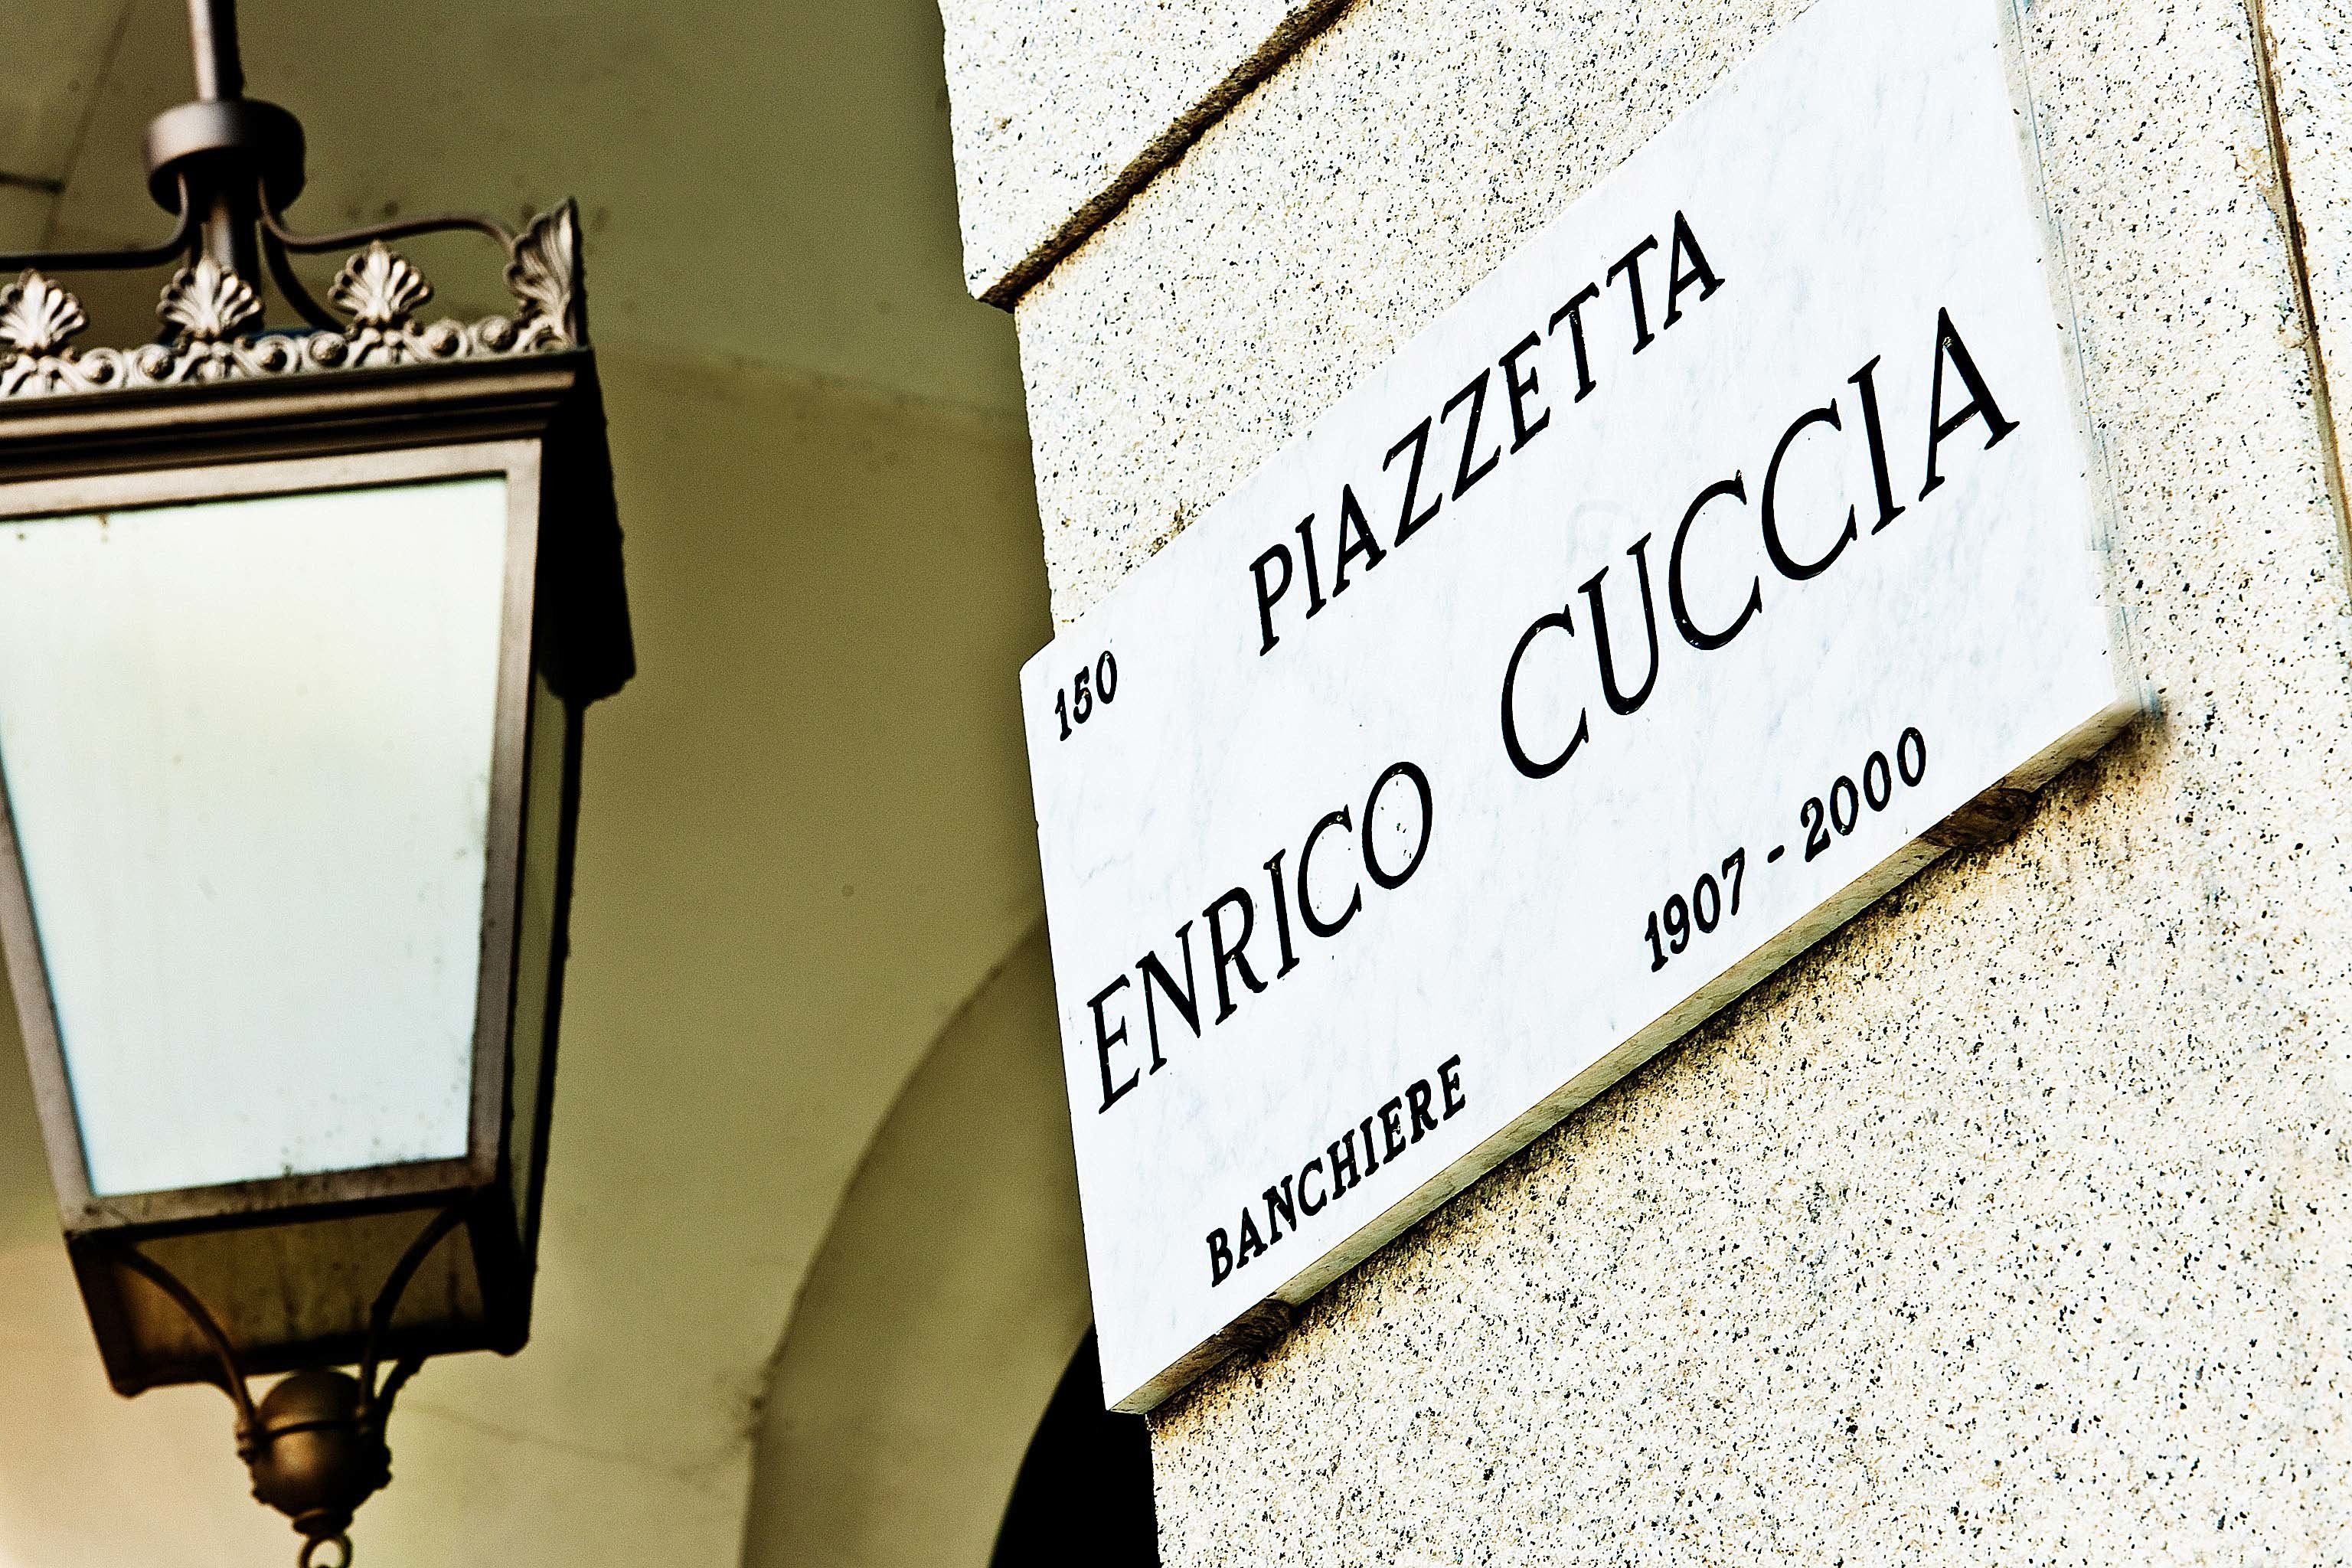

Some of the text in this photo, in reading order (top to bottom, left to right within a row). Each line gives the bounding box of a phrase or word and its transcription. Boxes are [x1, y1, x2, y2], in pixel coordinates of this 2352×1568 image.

[1249, 209, 1726, 657] PIAZZETTA
[1054, 650, 1118, 742] 150
[1086, 306, 2020, 1115] ENRICO CUCCIA
[1644, 846, 1746, 973] 1907
[1800, 727, 1926, 863] 2000
[1206, 1054, 1466, 1288] BANCHIERE
